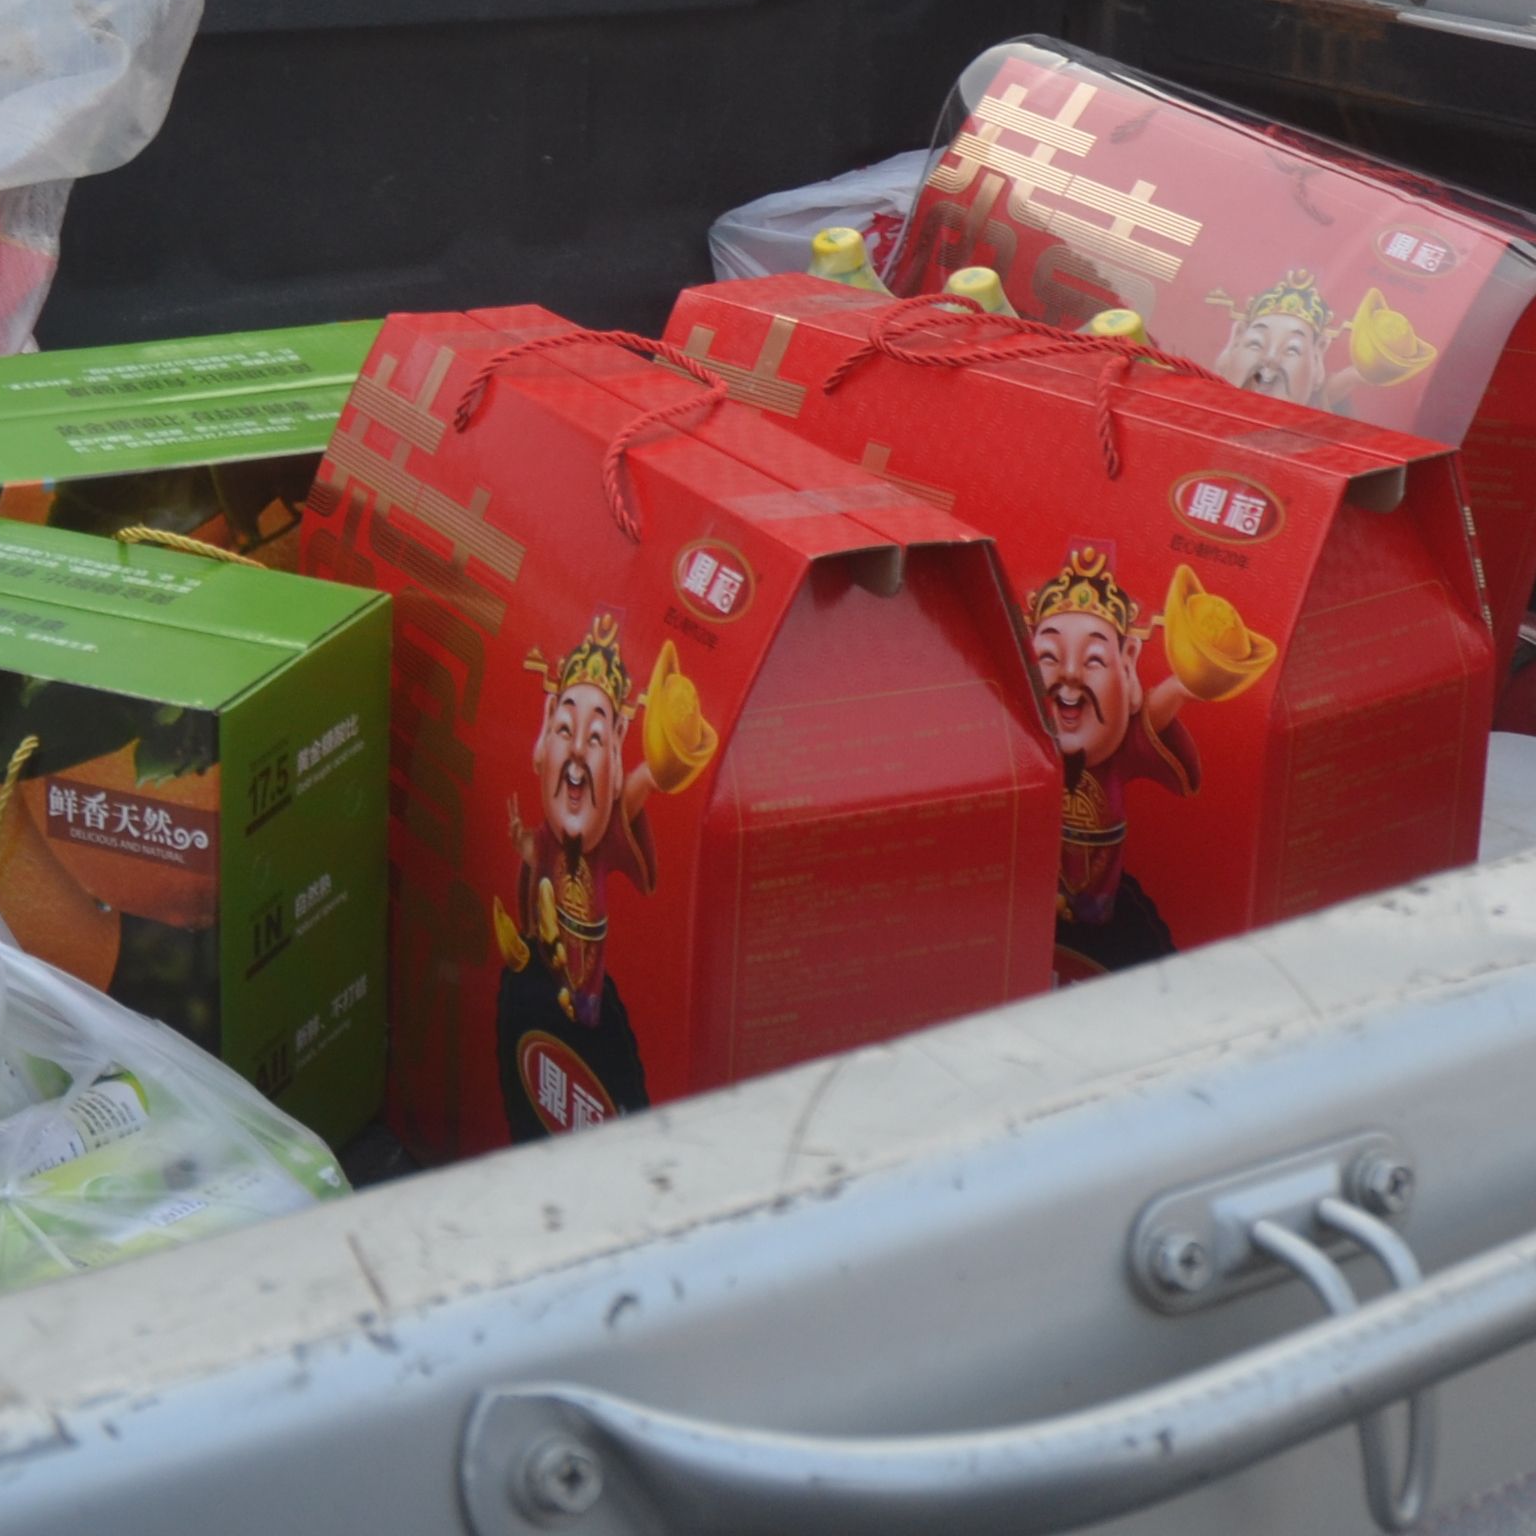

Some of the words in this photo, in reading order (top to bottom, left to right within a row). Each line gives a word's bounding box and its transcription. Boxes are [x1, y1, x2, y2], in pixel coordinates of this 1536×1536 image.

[1186, 482, 1267, 536] 鼎福
[48, 784, 173, 847] 鲜香天然
[69, 827, 119, 848] DELICIOUS
[120, 838, 143, 853] AND
[142, 843, 186, 864] NATURAL
